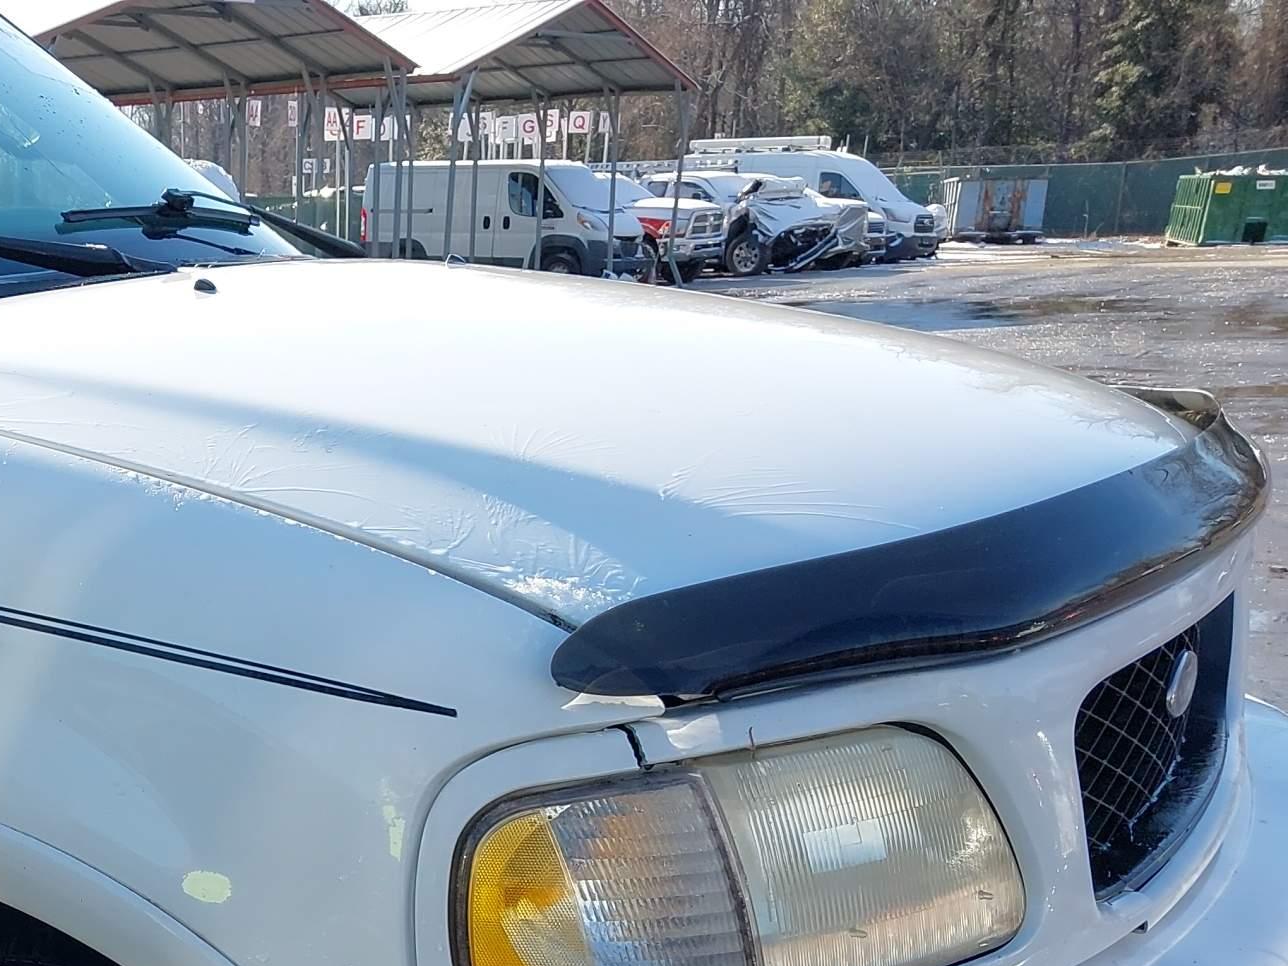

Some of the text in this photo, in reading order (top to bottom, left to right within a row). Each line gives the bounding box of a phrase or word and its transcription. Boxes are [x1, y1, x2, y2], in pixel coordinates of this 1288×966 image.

[355, 119, 367, 135] F
[522, 119, 536, 134] G
[573, 115, 585, 130] Q
